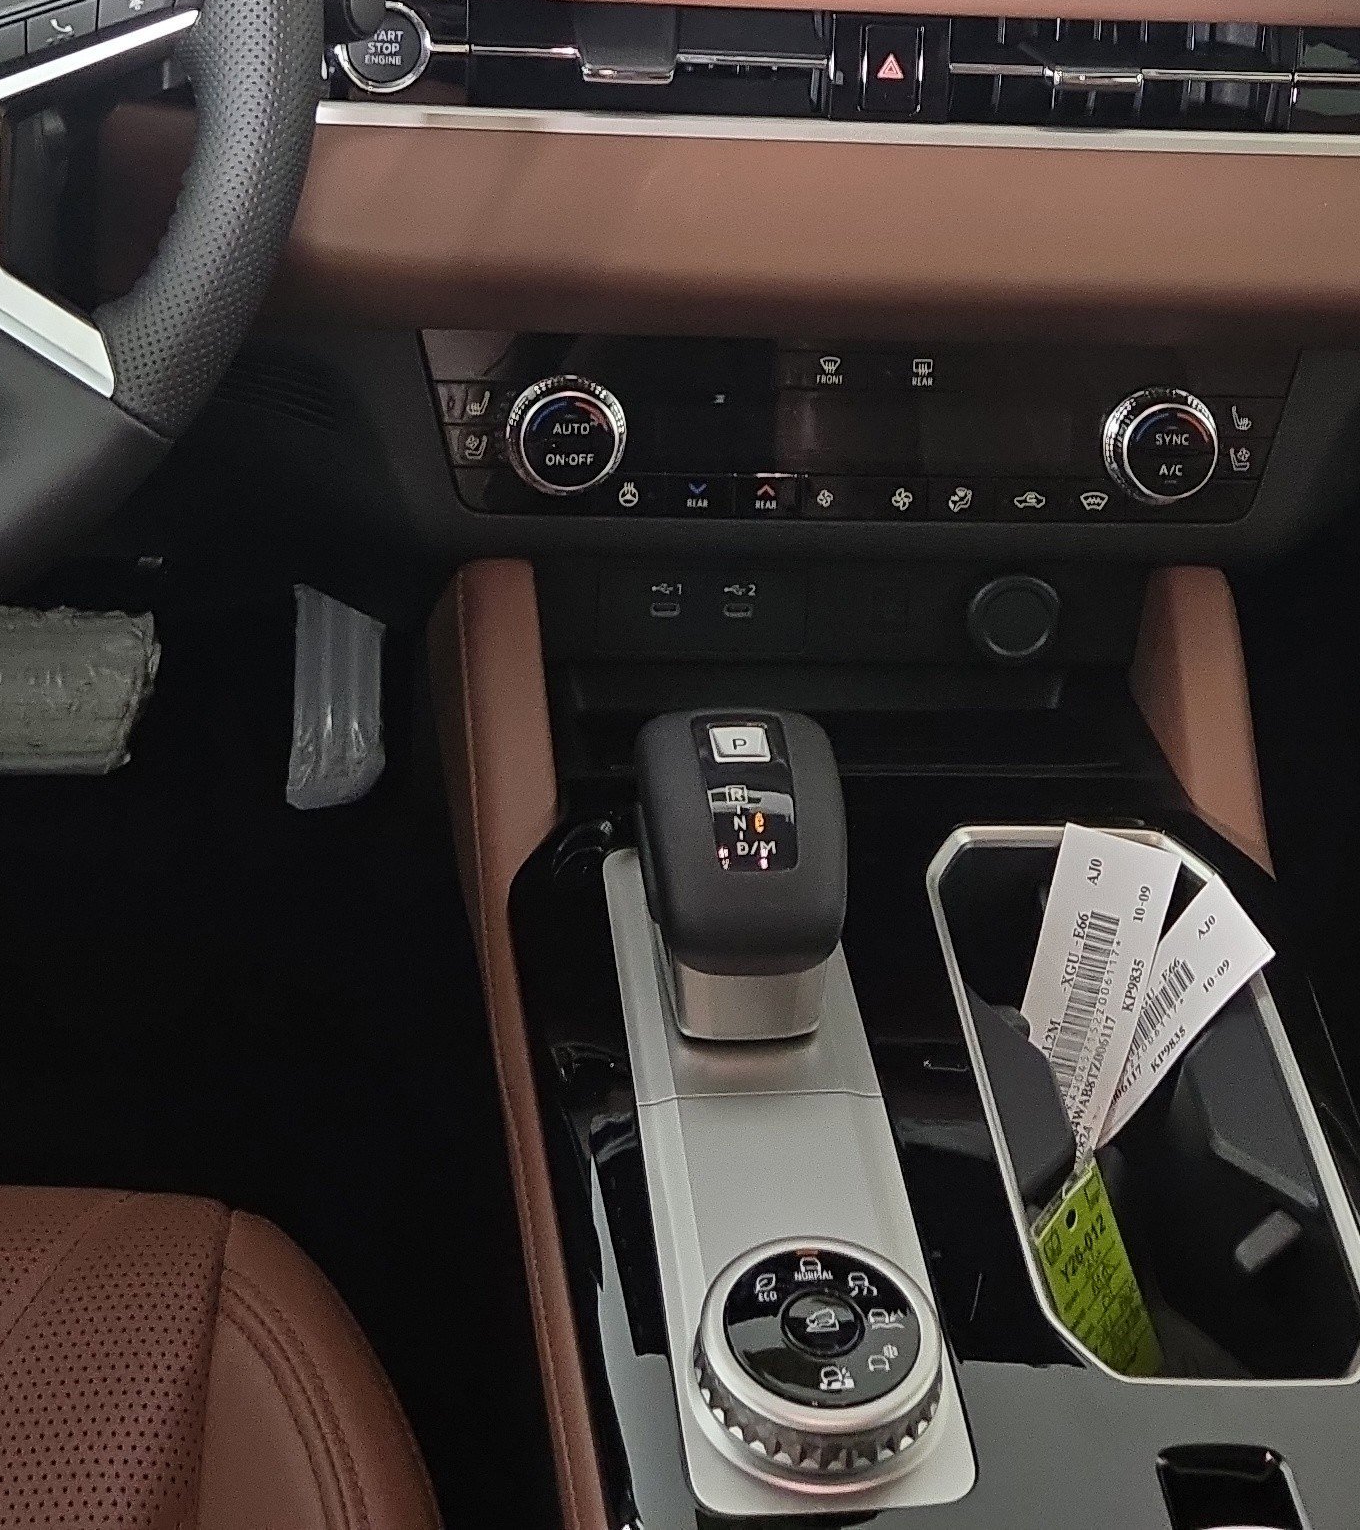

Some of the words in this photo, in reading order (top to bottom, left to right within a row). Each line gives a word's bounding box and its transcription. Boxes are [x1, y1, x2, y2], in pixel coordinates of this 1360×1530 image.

[368, 42, 399, 54] STOP
[365, 55, 401, 65] ENGINE
[816, 375, 843, 385] FRONT
[912, 377, 933, 387] REAR
[553, 423, 590, 435] AUTO
[1155, 434, 1189, 446] SYNC
[1159, 464, 1183, 476] A/C
[687, 499, 708, 508] REAR
[755, 499, 776, 509] REAR
[677, 584, 682, 594] 1
[748, 585, 756, 595] 2
[733, 738, 747, 750] P
[731, 788, 742, 801] R
[734, 816, 746, 831] N
[1133, 886, 1151, 922] 10-09
[1202, 959, 1230, 993] 10-09
[1121, 958, 1145, 1012] KP9835
[1150, 1025, 1186, 1073] KP9835
[795, 1271, 833, 1281] NORMAL
[758, 1293, 777, 1301] ECO
